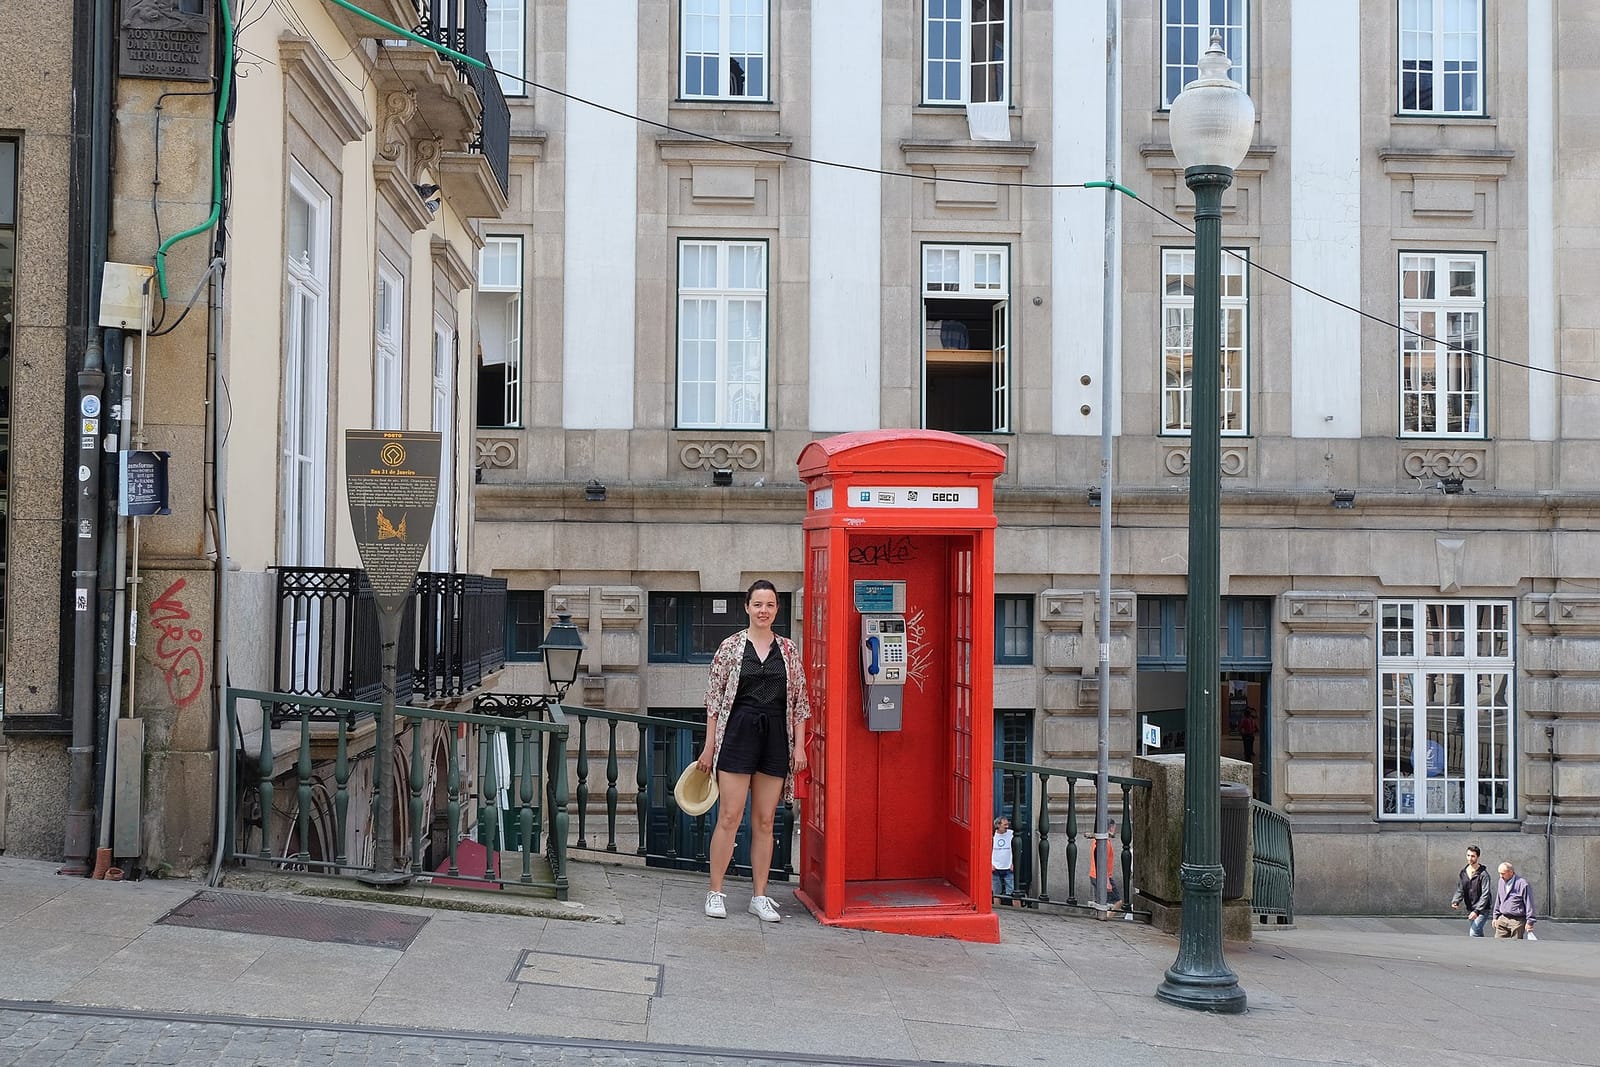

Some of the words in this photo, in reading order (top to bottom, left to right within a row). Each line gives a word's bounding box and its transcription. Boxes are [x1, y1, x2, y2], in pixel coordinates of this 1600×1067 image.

[127, 29, 148, 40] AOS
[150, 31, 201, 42] VENCIDOS
[127, 40, 140, 49] DA
[129, 50, 200, 64] REPUBLICANA
